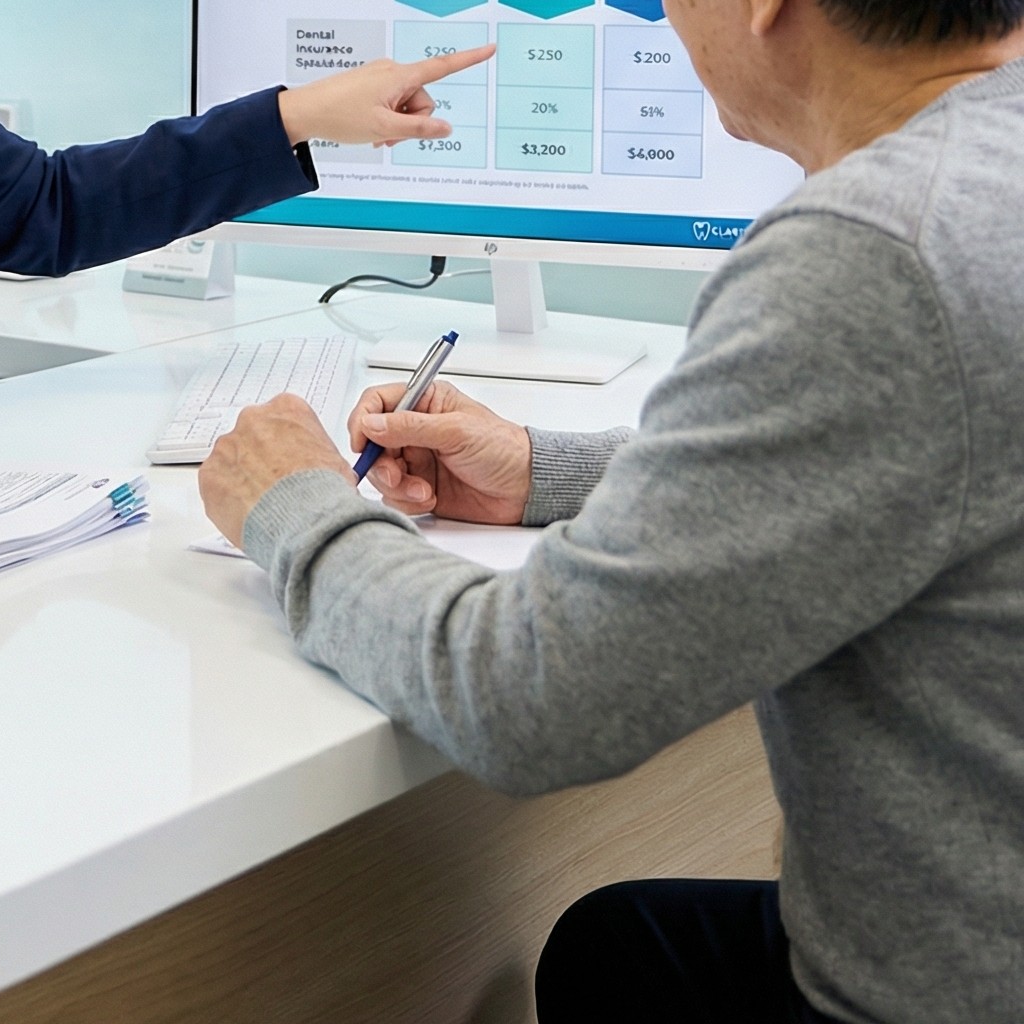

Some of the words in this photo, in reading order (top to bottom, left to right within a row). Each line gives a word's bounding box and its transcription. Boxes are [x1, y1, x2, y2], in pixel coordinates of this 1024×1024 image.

[296, 29, 335, 40] Dental
[527, 49, 563, 61] $250
[633, 51, 671, 64] $200
[531, 102, 559, 114] 20%
[521, 143, 566, 156] $3,200
